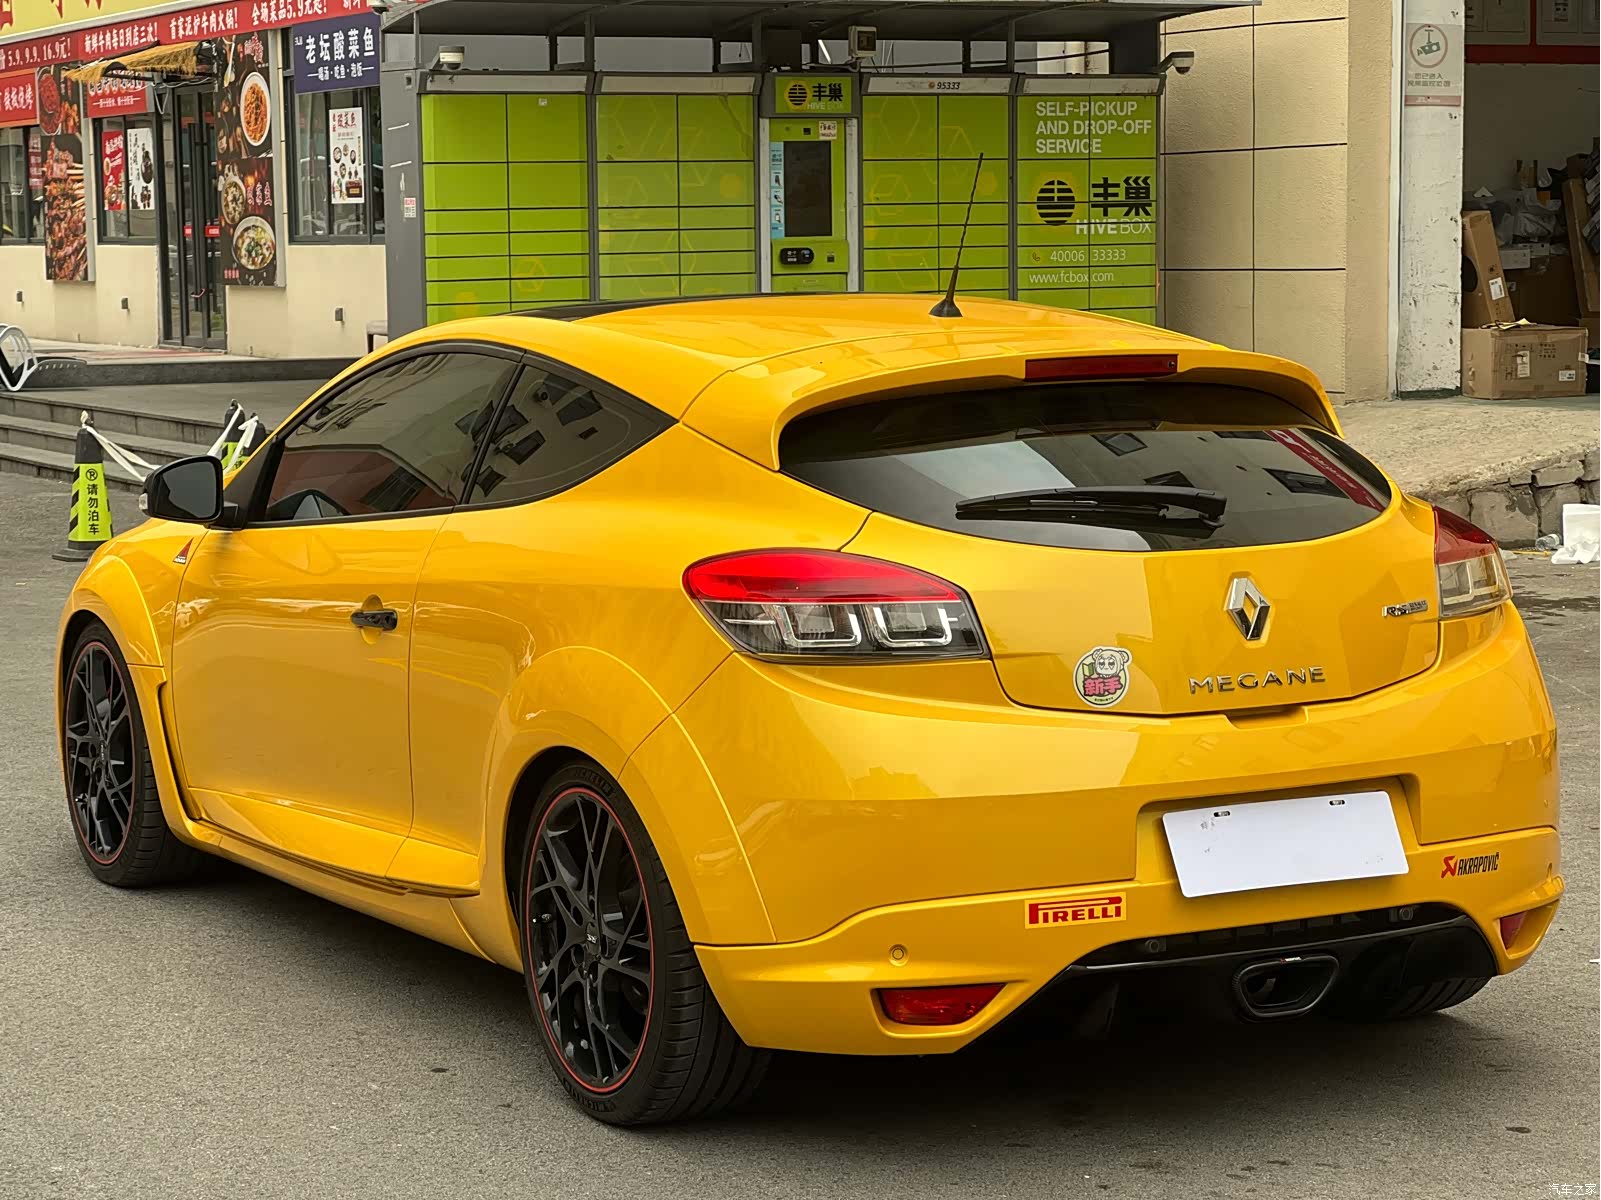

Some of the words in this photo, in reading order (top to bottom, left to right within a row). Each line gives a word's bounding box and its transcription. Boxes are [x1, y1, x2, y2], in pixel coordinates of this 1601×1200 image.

[305, 26, 375, 64] 老坛酸菜鱼
[812, 83, 843, 101] 丰巢
[936, 81, 960, 90] 95333
[807, 102, 826, 110] HIVE
[1036, 101, 1138, 117] SELF-PICKUP
[1036, 120, 1069, 135] AND
[1073, 119, 1152, 135] DROP-OFF
[1036, 138, 1102, 154] SERVICE
[1091, 176, 1153, 217] 丰巢
[1076, 219, 1118, 235] HIVE
[1120, 218, 1152, 234] BOX
[1050, 250, 1085, 262] 40006
[1093, 249, 1127, 261] 33333
[1029, 271, 1115, 283] www.fcbox.com
[86, 483, 100, 535] 请勿泊车
[1083, 676, 1123, 696] 新手
[1188, 666, 1326, 694] MEGANE
[1028, 896, 1123, 925] PIRELLI
